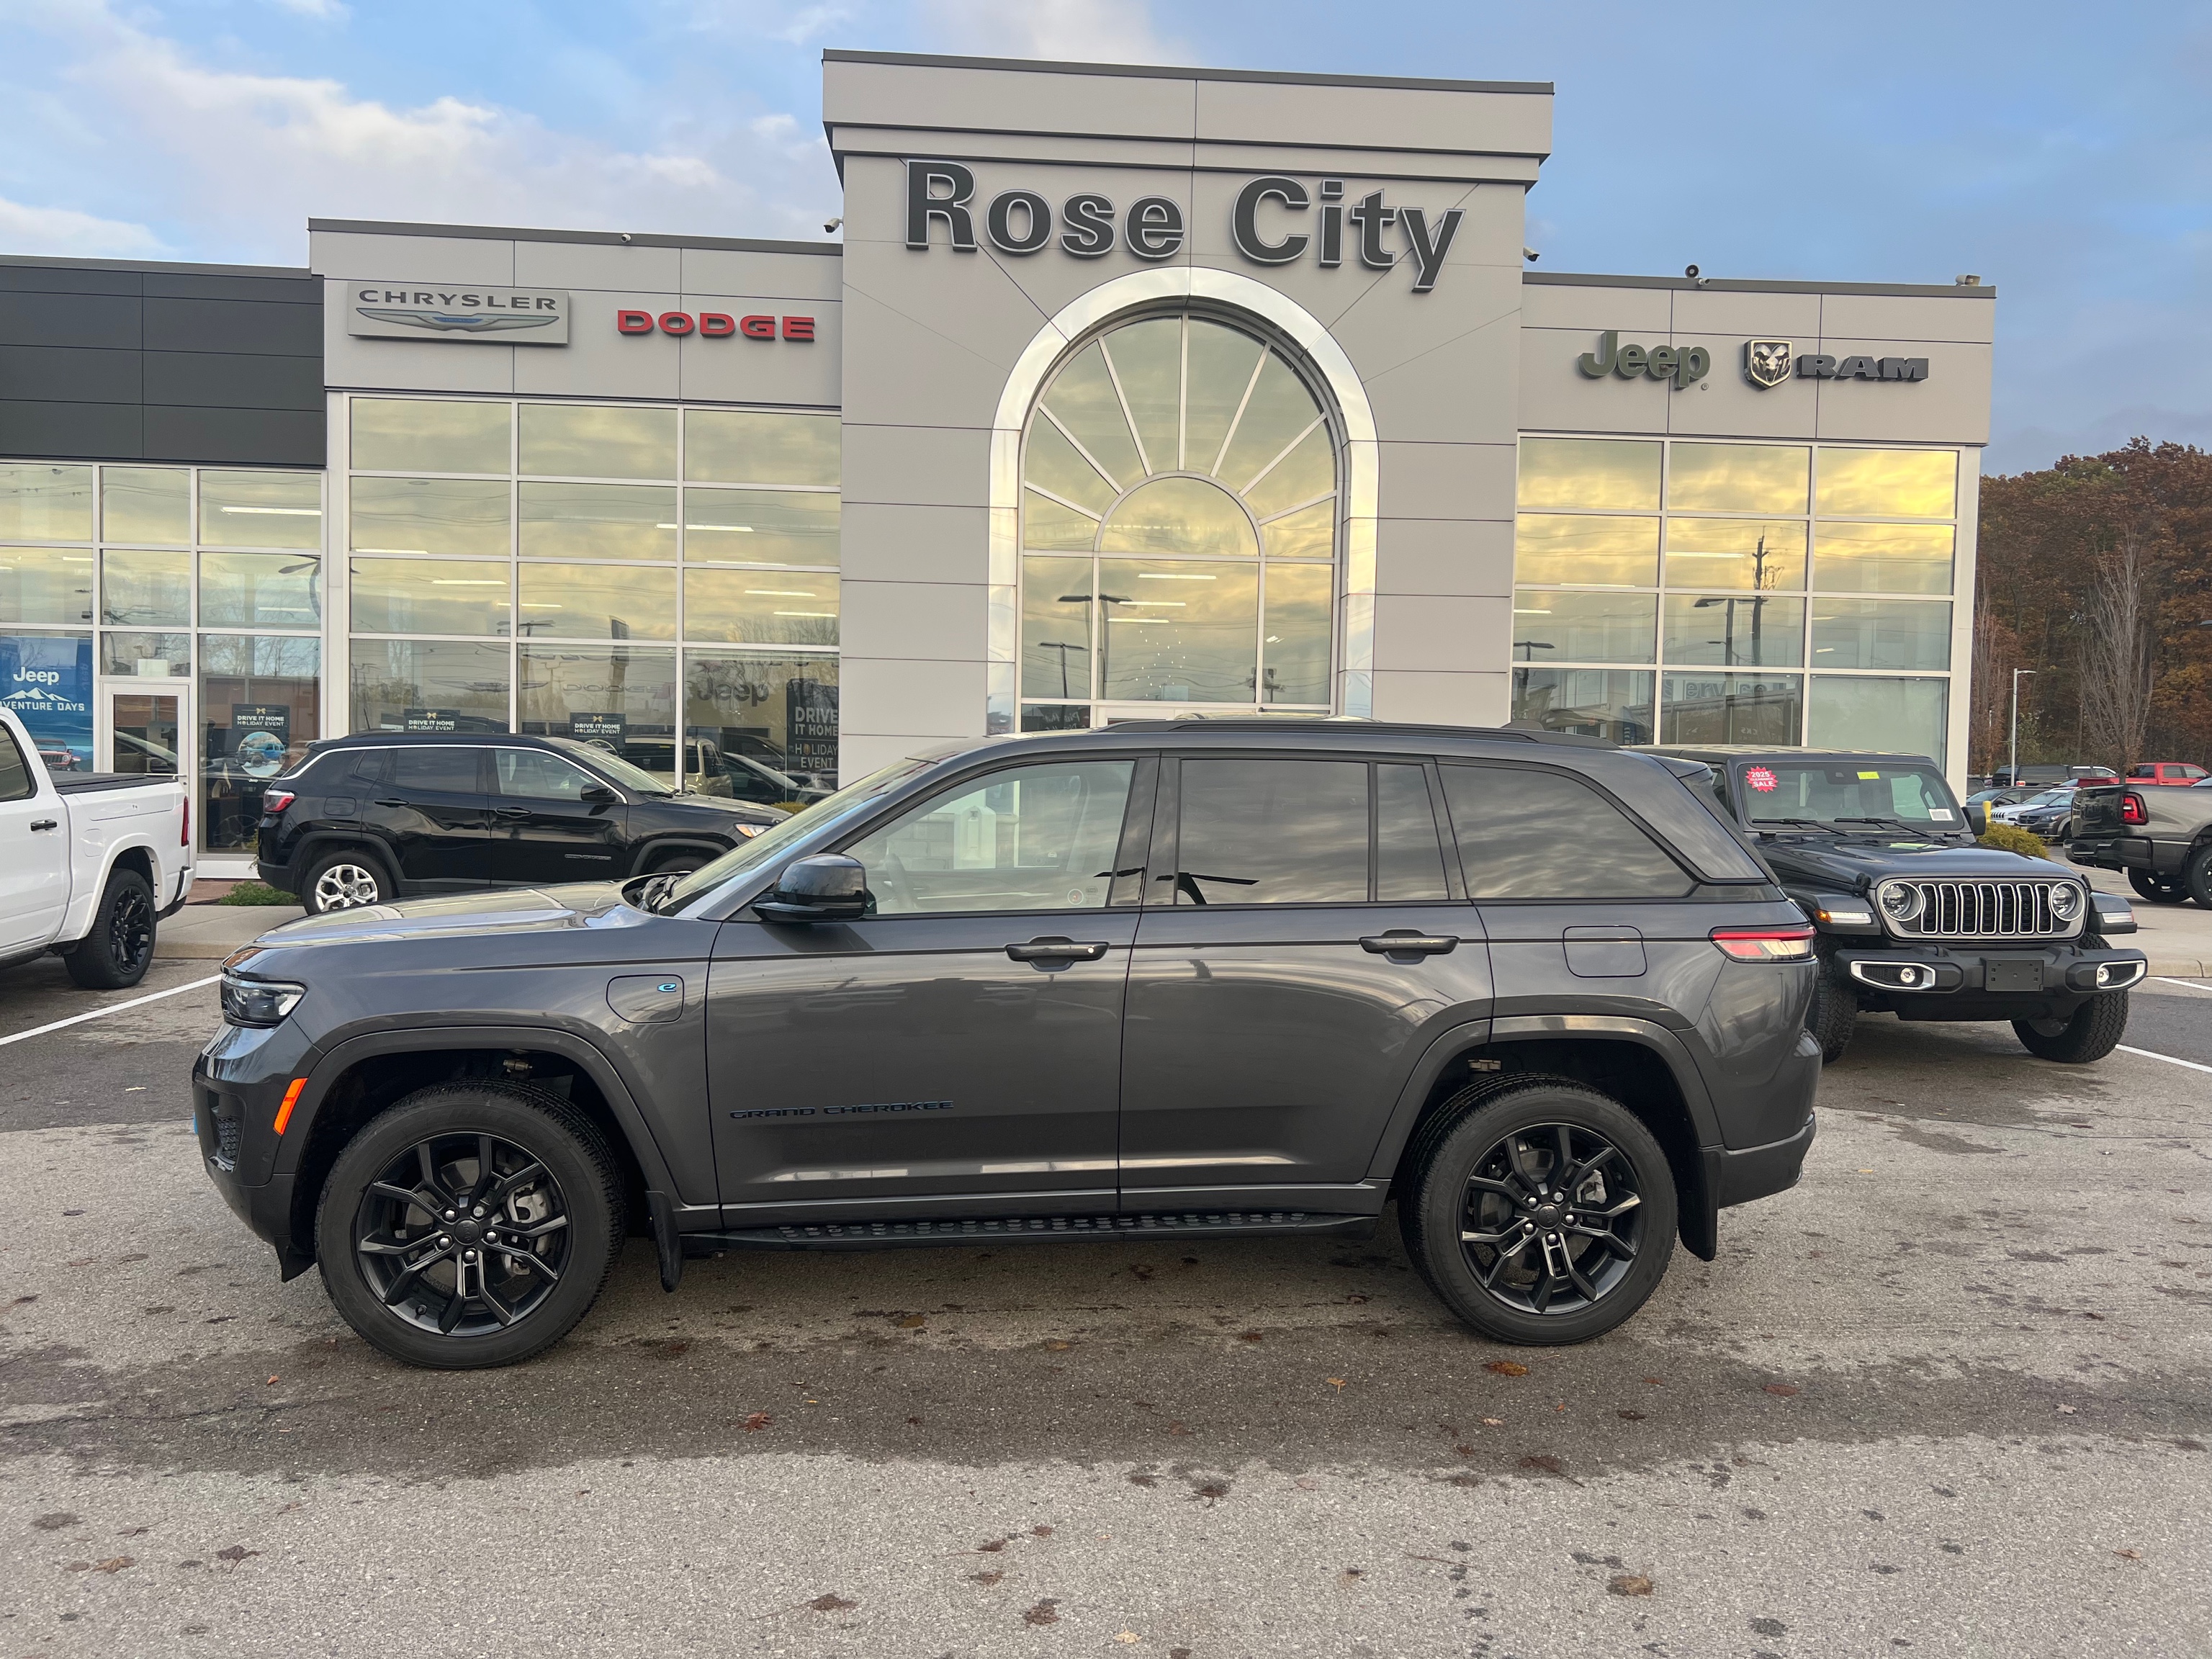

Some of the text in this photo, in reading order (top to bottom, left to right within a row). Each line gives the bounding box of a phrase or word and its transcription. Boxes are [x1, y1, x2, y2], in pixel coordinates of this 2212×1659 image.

[905, 159, 1467, 293] Rose City
[359, 289, 557, 311] CHRYSLER
[617, 310, 816, 342] DODGE
[1578, 331, 1711, 390] Jeep
[1797, 354, 1930, 382] RAM
[13, 666, 60, 685] Jeep
[0, 701, 85, 711] VENTURE DAYS
[795, 706, 838, 724] DRIVE
[795, 724, 838, 737] IT HOME
[801, 757, 833, 769] EVENT
[729, 1100, 955, 1119] GRAND CHEROKEE
